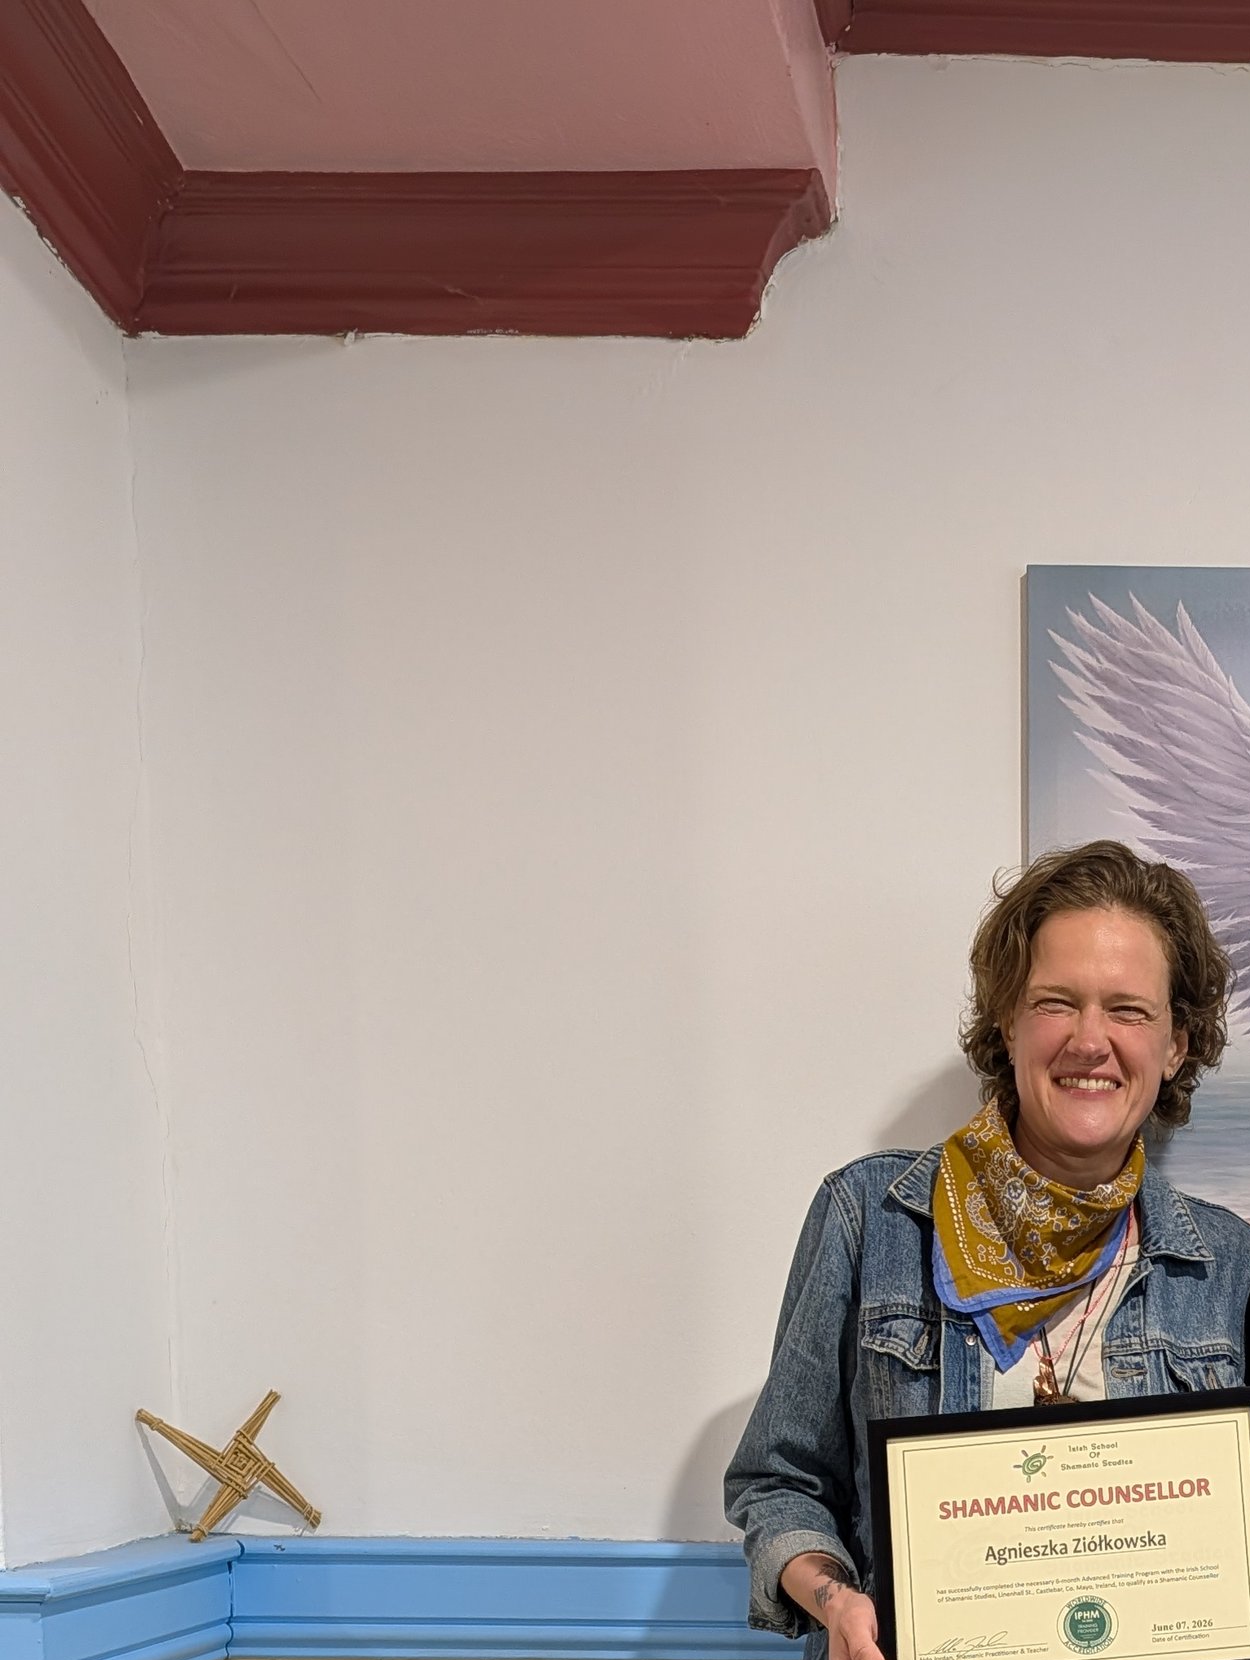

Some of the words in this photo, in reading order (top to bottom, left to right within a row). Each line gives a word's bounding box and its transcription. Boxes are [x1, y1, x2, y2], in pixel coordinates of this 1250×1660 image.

[1068, 1444, 1088, 1452] Irish
[1091, 1442, 1118, 1450] School
[1060, 1462, 1100, 1471] Shamanic
[1102, 1459, 1133, 1468] Studies
[939, 1491, 1061, 1520] SHAMANIC
[1066, 1478, 1212, 1508] COUNSELLOR
[1088, 1519, 1110, 1527] certifies
[985, 1539, 1068, 1565] Agnieszka
[1072, 1530, 1166, 1554] Ziółkowska
[948, 1586, 982, 1594] successfully
[982, 1583, 1014, 1592] completed
[1082, 1574, 1110, 1582] Advanced
[998, 1590, 1024, 1598] Linenhall
[1126, 1578, 1146, 1587] qualify
[1188, 1573, 1219, 1581] Counsellor
[1065, 1595, 1106, 1609] WORLDWIDE
[1074, 1610, 1100, 1620] IPHM
[1152, 1624, 1174, 1632] June
[1176, 1621, 1190, 1630] 07,
[1192, 1619, 1213, 1628] 2026
[1174, 1633, 1210, 1641] Certification
[1062, 1636, 1114, 1655] ACCREDITATION
[985, 1649, 1019, 1657] Practitioner
